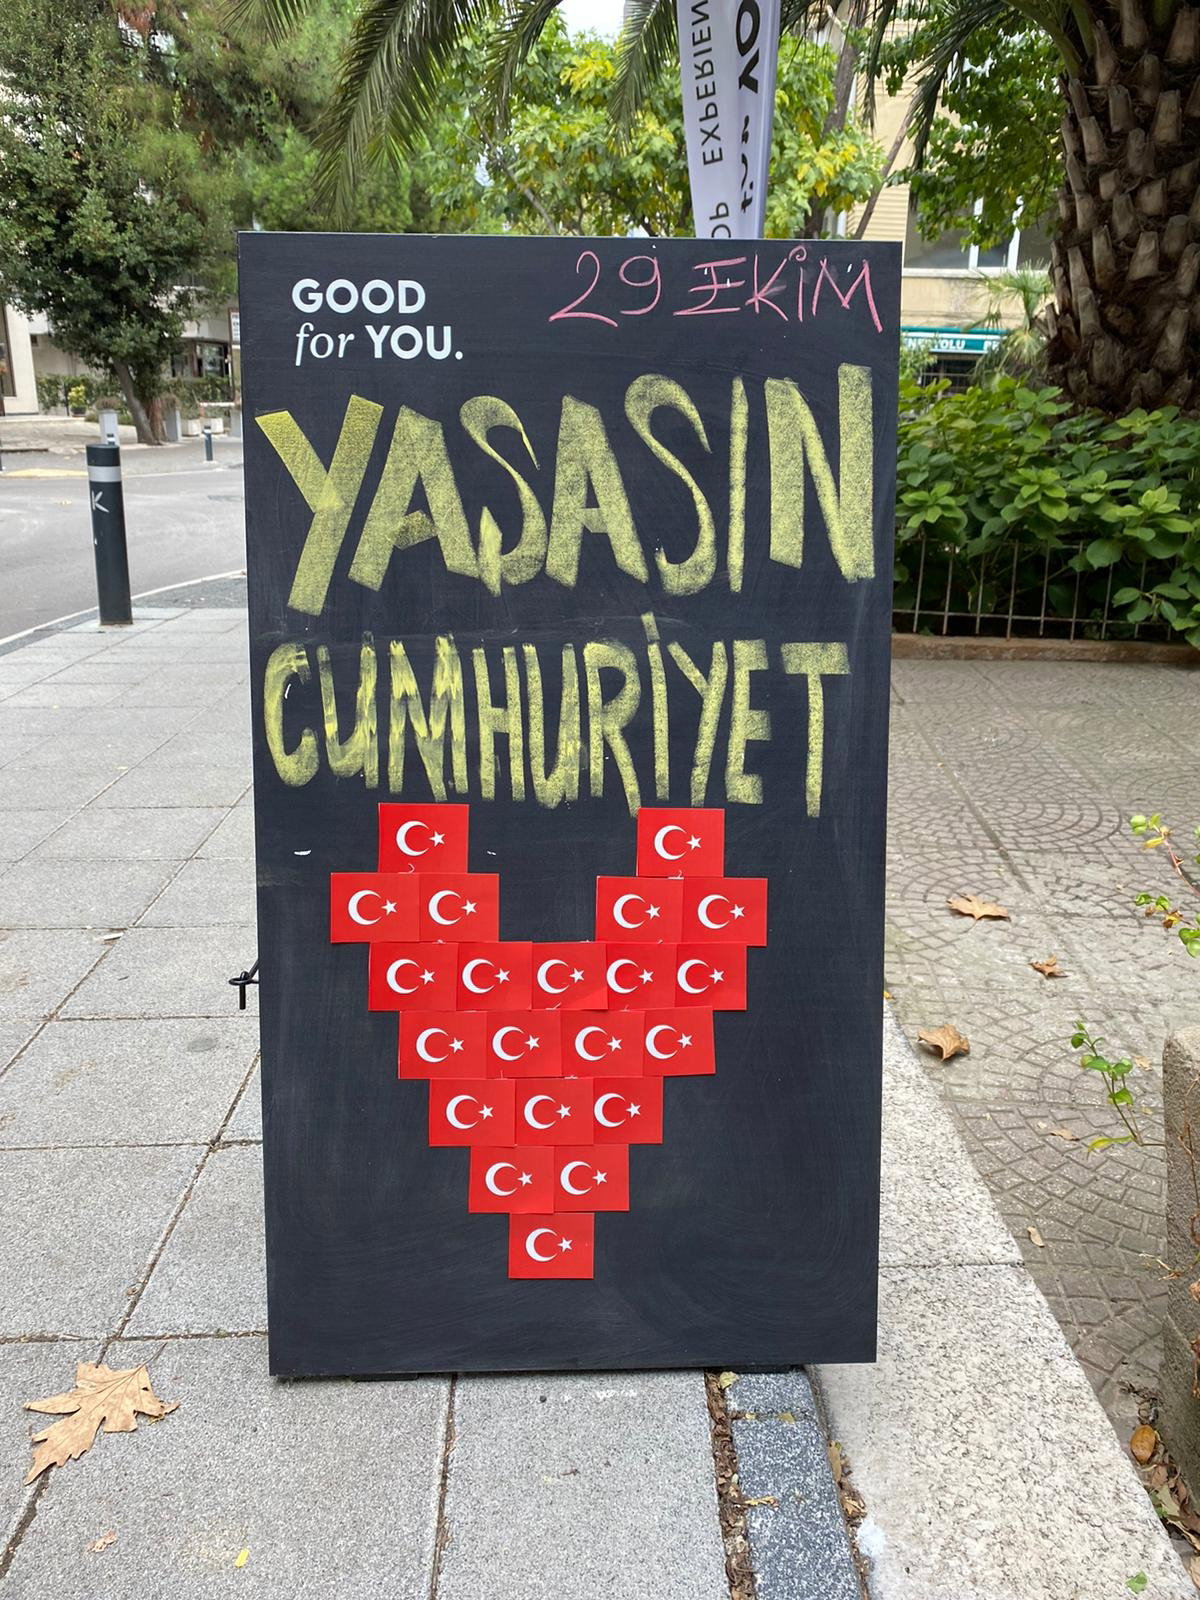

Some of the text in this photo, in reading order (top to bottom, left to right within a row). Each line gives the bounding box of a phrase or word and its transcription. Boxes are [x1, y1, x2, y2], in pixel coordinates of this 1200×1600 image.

[291, 278, 426, 314] GOOD
[549, 250, 663, 327] 29
[295, 322, 464, 366] for YOU.
[263, 611, 851, 818] CUMHURİYET
